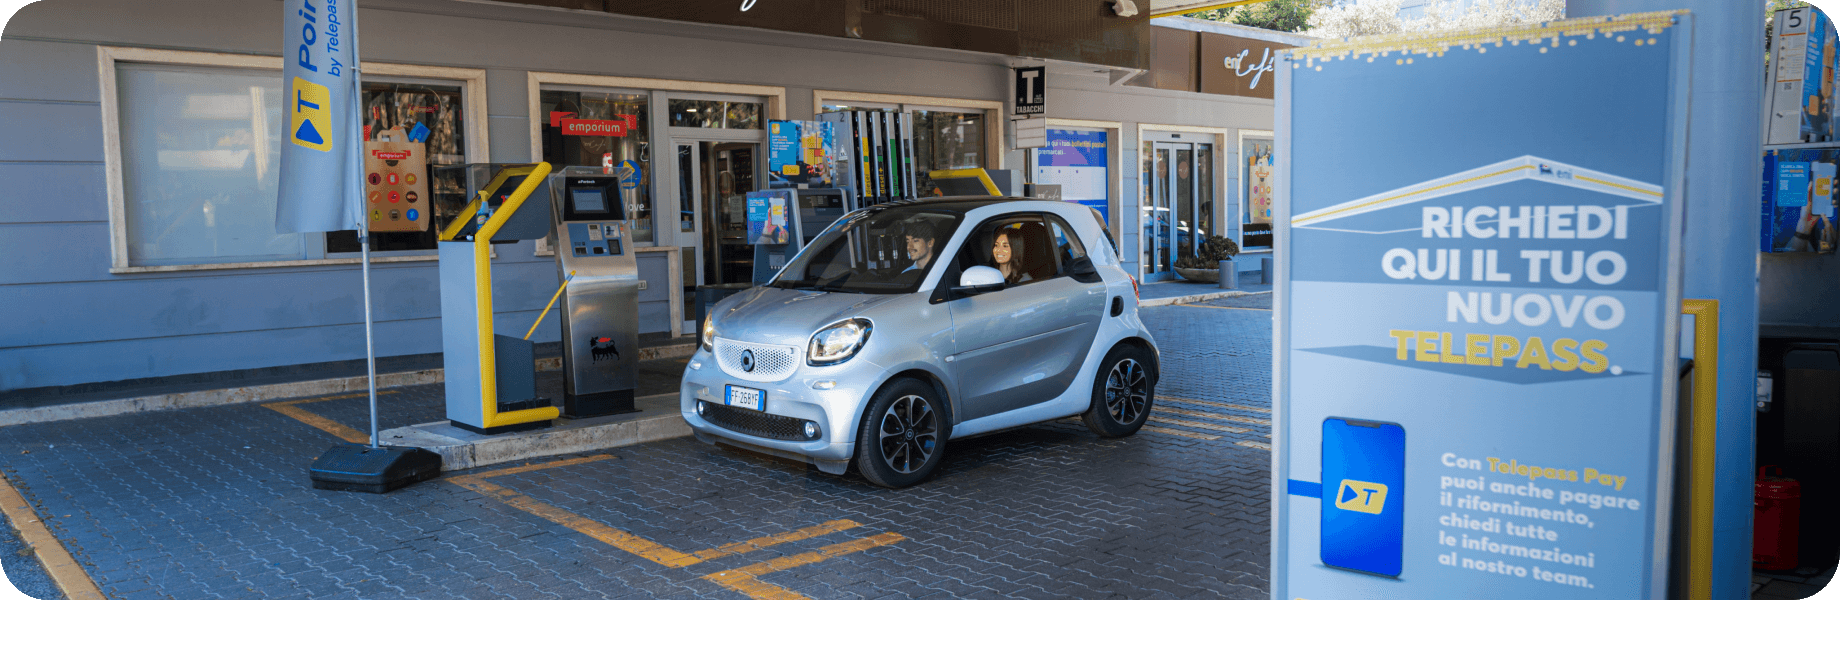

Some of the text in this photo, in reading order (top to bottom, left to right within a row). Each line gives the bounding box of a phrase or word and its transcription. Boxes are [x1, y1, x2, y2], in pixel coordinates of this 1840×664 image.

[1788, 10, 1802, 28] 5
[327, 57, 343, 77] by
[1021, 70, 1039, 104] T
[568, 121, 621, 134] emporium
[1016, 105, 1044, 114] TABACCHI
[1422, 205, 1628, 239] RICHIEDI
[1381, 247, 1627, 285] QUI IL TUO
[1447, 290, 1626, 330] NUOVO
[1389, 329, 1623, 375] TELEPASS.
[1440, 452, 1627, 491] Con Telepass Pay
[1439, 491, 1595, 529] il rifornimento,
[1440, 475, 1641, 511] puoi anche pagare
[1438, 512, 1558, 542] chiedi tutte
[1438, 530, 1595, 568] le informazioni
[1438, 552, 1595, 589] al nostro team.
